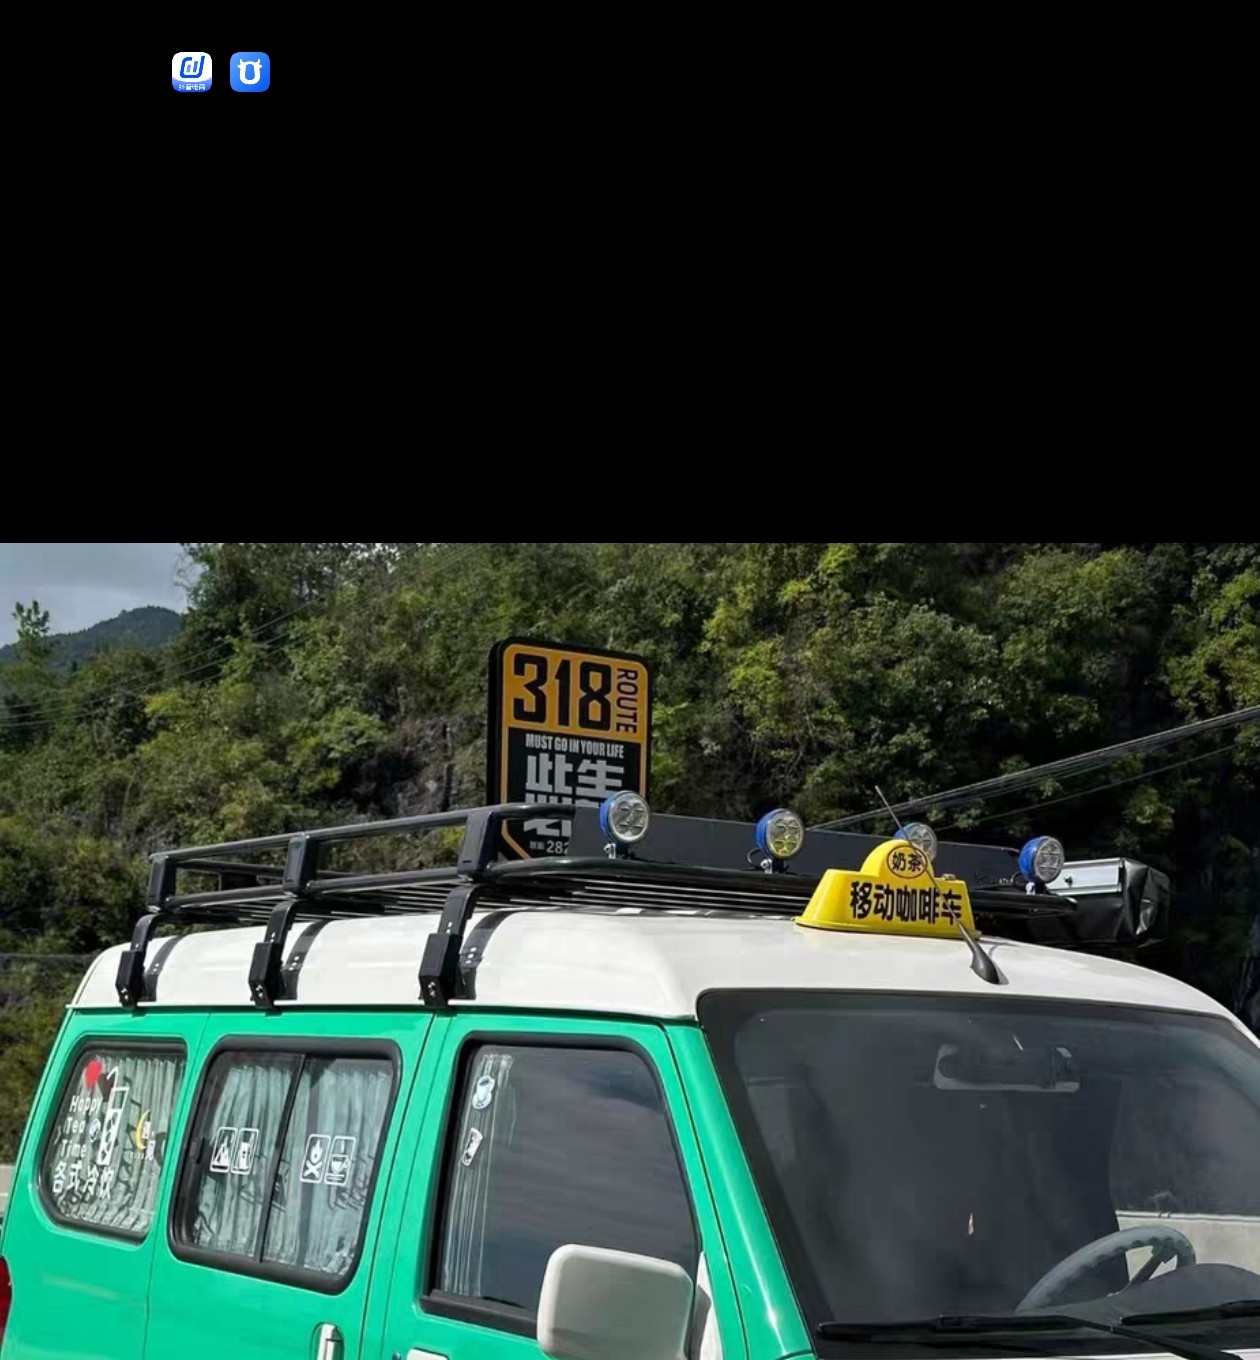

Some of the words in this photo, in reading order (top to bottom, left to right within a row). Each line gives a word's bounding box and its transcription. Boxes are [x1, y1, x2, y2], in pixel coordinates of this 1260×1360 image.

[513, 653, 612, 732] 318
[616, 667, 639, 735] ROUTE
[525, 733, 553, 750] MUST
[554, 737, 568, 752] GO
[569, 739, 579, 754] IN
[580, 740, 605, 756] YOUR
[606, 743, 624, 759] LIFE
[525, 753, 625, 800] 此生
[891, 852, 923, 873] 奶茶
[850, 880, 962, 926] 移动咖啡车
[69, 1095, 103, 1117] Happy
[66, 1116, 86, 1135] Tea
[61, 1139, 87, 1159] Time
[53, 1160, 114, 1200] 各式冷饮
